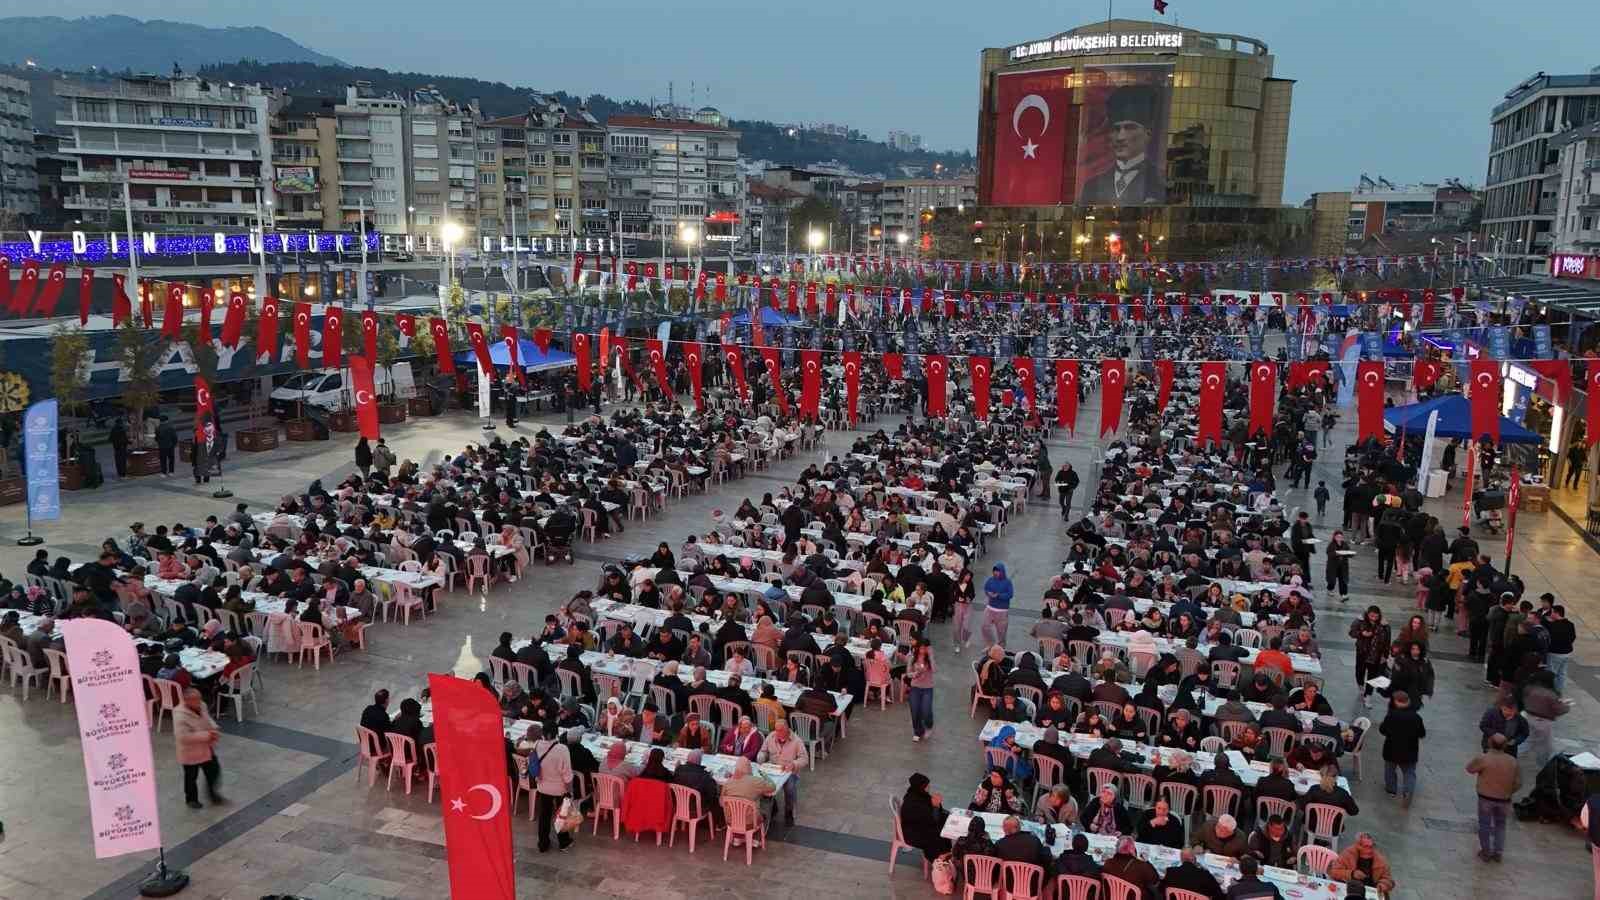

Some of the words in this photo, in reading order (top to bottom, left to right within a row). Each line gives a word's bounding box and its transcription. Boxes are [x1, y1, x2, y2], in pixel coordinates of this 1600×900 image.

[1029, 41, 1052, 56] AYDIN
[1054, 33, 1117, 52] BÜYÜKŞEHİR
[1120, 32, 1183, 48] BELEDİYESİ
